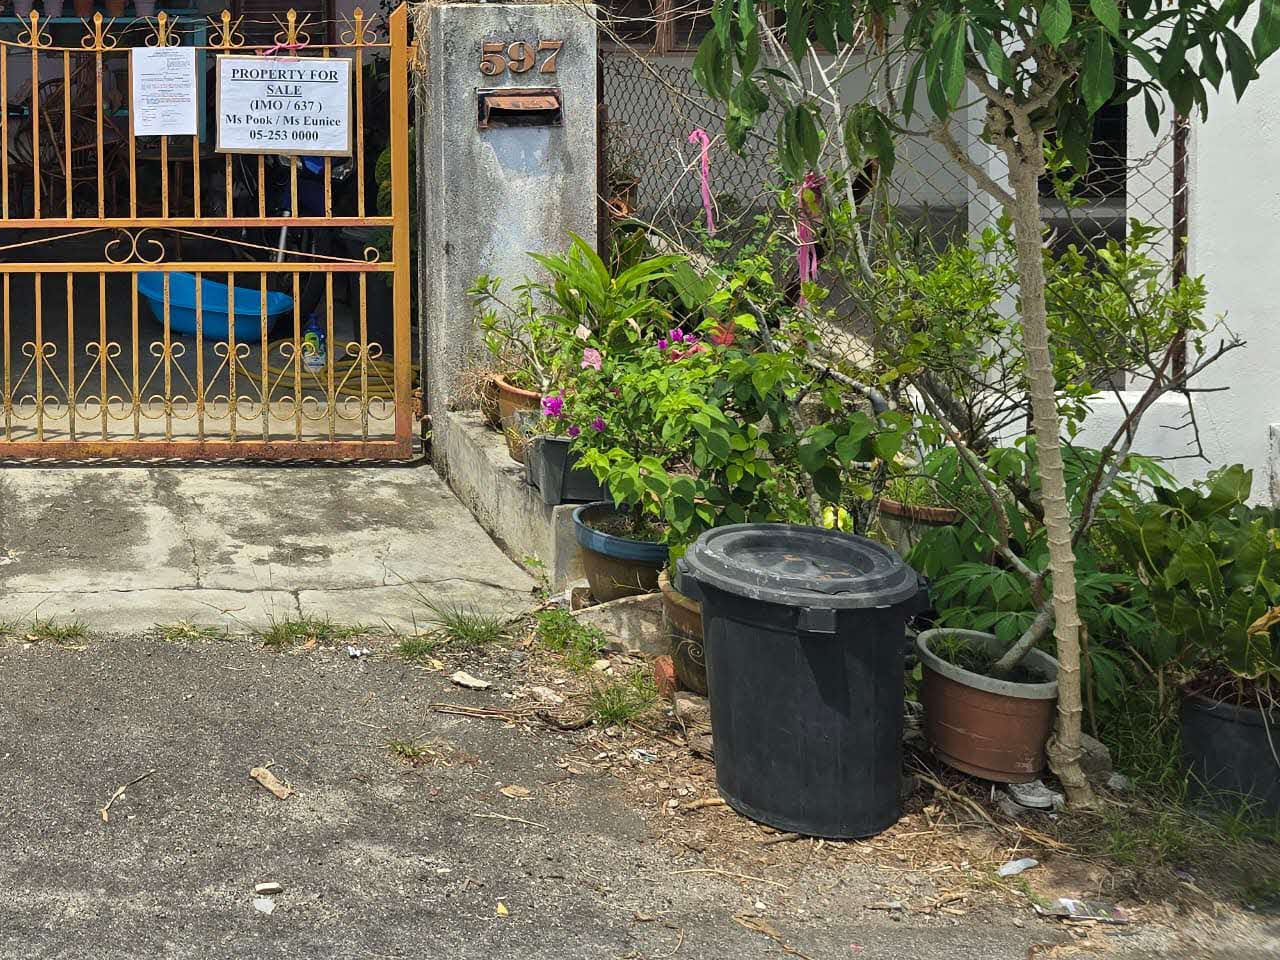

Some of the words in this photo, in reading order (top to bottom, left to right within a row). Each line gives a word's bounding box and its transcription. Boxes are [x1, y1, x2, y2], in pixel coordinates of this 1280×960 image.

[479, 40, 563, 76] 597
[231, 68, 306, 80] PROPERTY
[310, 69, 338, 81] FOR
[266, 85, 302, 96] SALE
[250, 99, 283, 112] (IMO
[294, 101, 314, 111] 637
[226, 114, 242, 124] Ms
[246, 114, 273, 125] Pook
[283, 115, 300, 126] Ms
[304, 116, 341, 127] Eunice
[249, 129, 288, 140] 05-253
[291, 130, 319, 141] 0000
